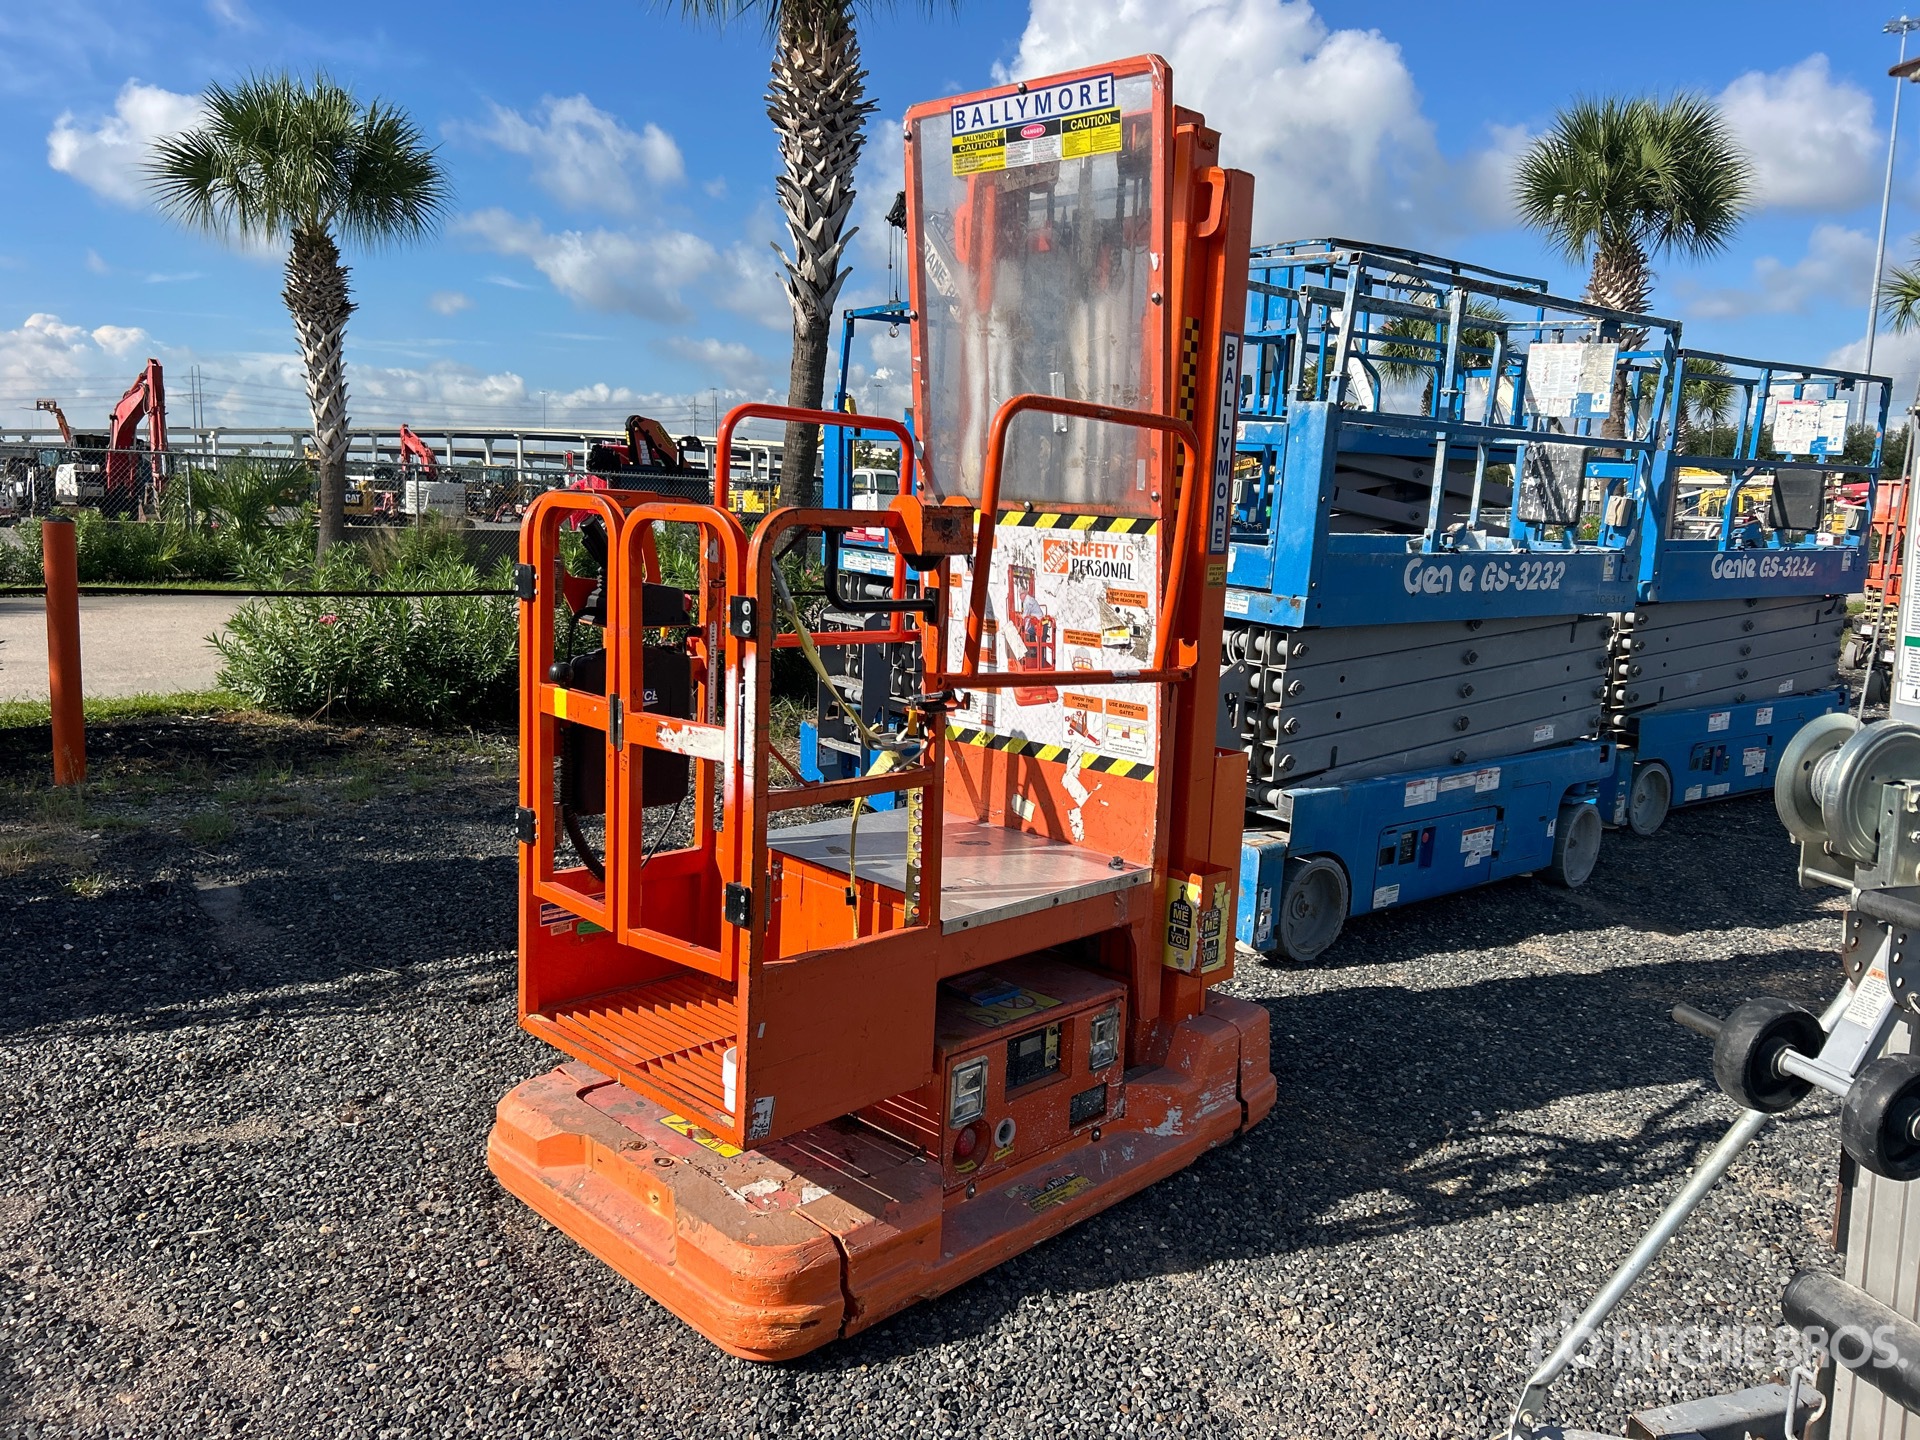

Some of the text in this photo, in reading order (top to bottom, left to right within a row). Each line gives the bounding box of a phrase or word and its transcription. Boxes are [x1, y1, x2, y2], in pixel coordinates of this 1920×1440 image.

[955, 79, 1109, 132] BALLYMORE
[1070, 112, 1112, 131] CAUTION
[962, 131, 996, 143] BALLYMORE
[1023, 127, 1044, 136] DANGER
[959, 139, 999, 152] CAUTION
[1213, 342, 1236, 545] BALLYMORE
[345, 493, 360, 504] CAT
[1070, 540, 1134, 561] SAFETY IS
[1071, 558, 1136, 581] PERSONAL
[1710, 552, 1756, 580] Genie
[1480, 560, 1566, 592] GS-3232
[1119, 703, 1146, 712] BARRICADE
[1173, 902, 1190, 912] PLUG
[1173, 908, 1189, 922] ME
[1171, 934, 1188, 946] YOU
